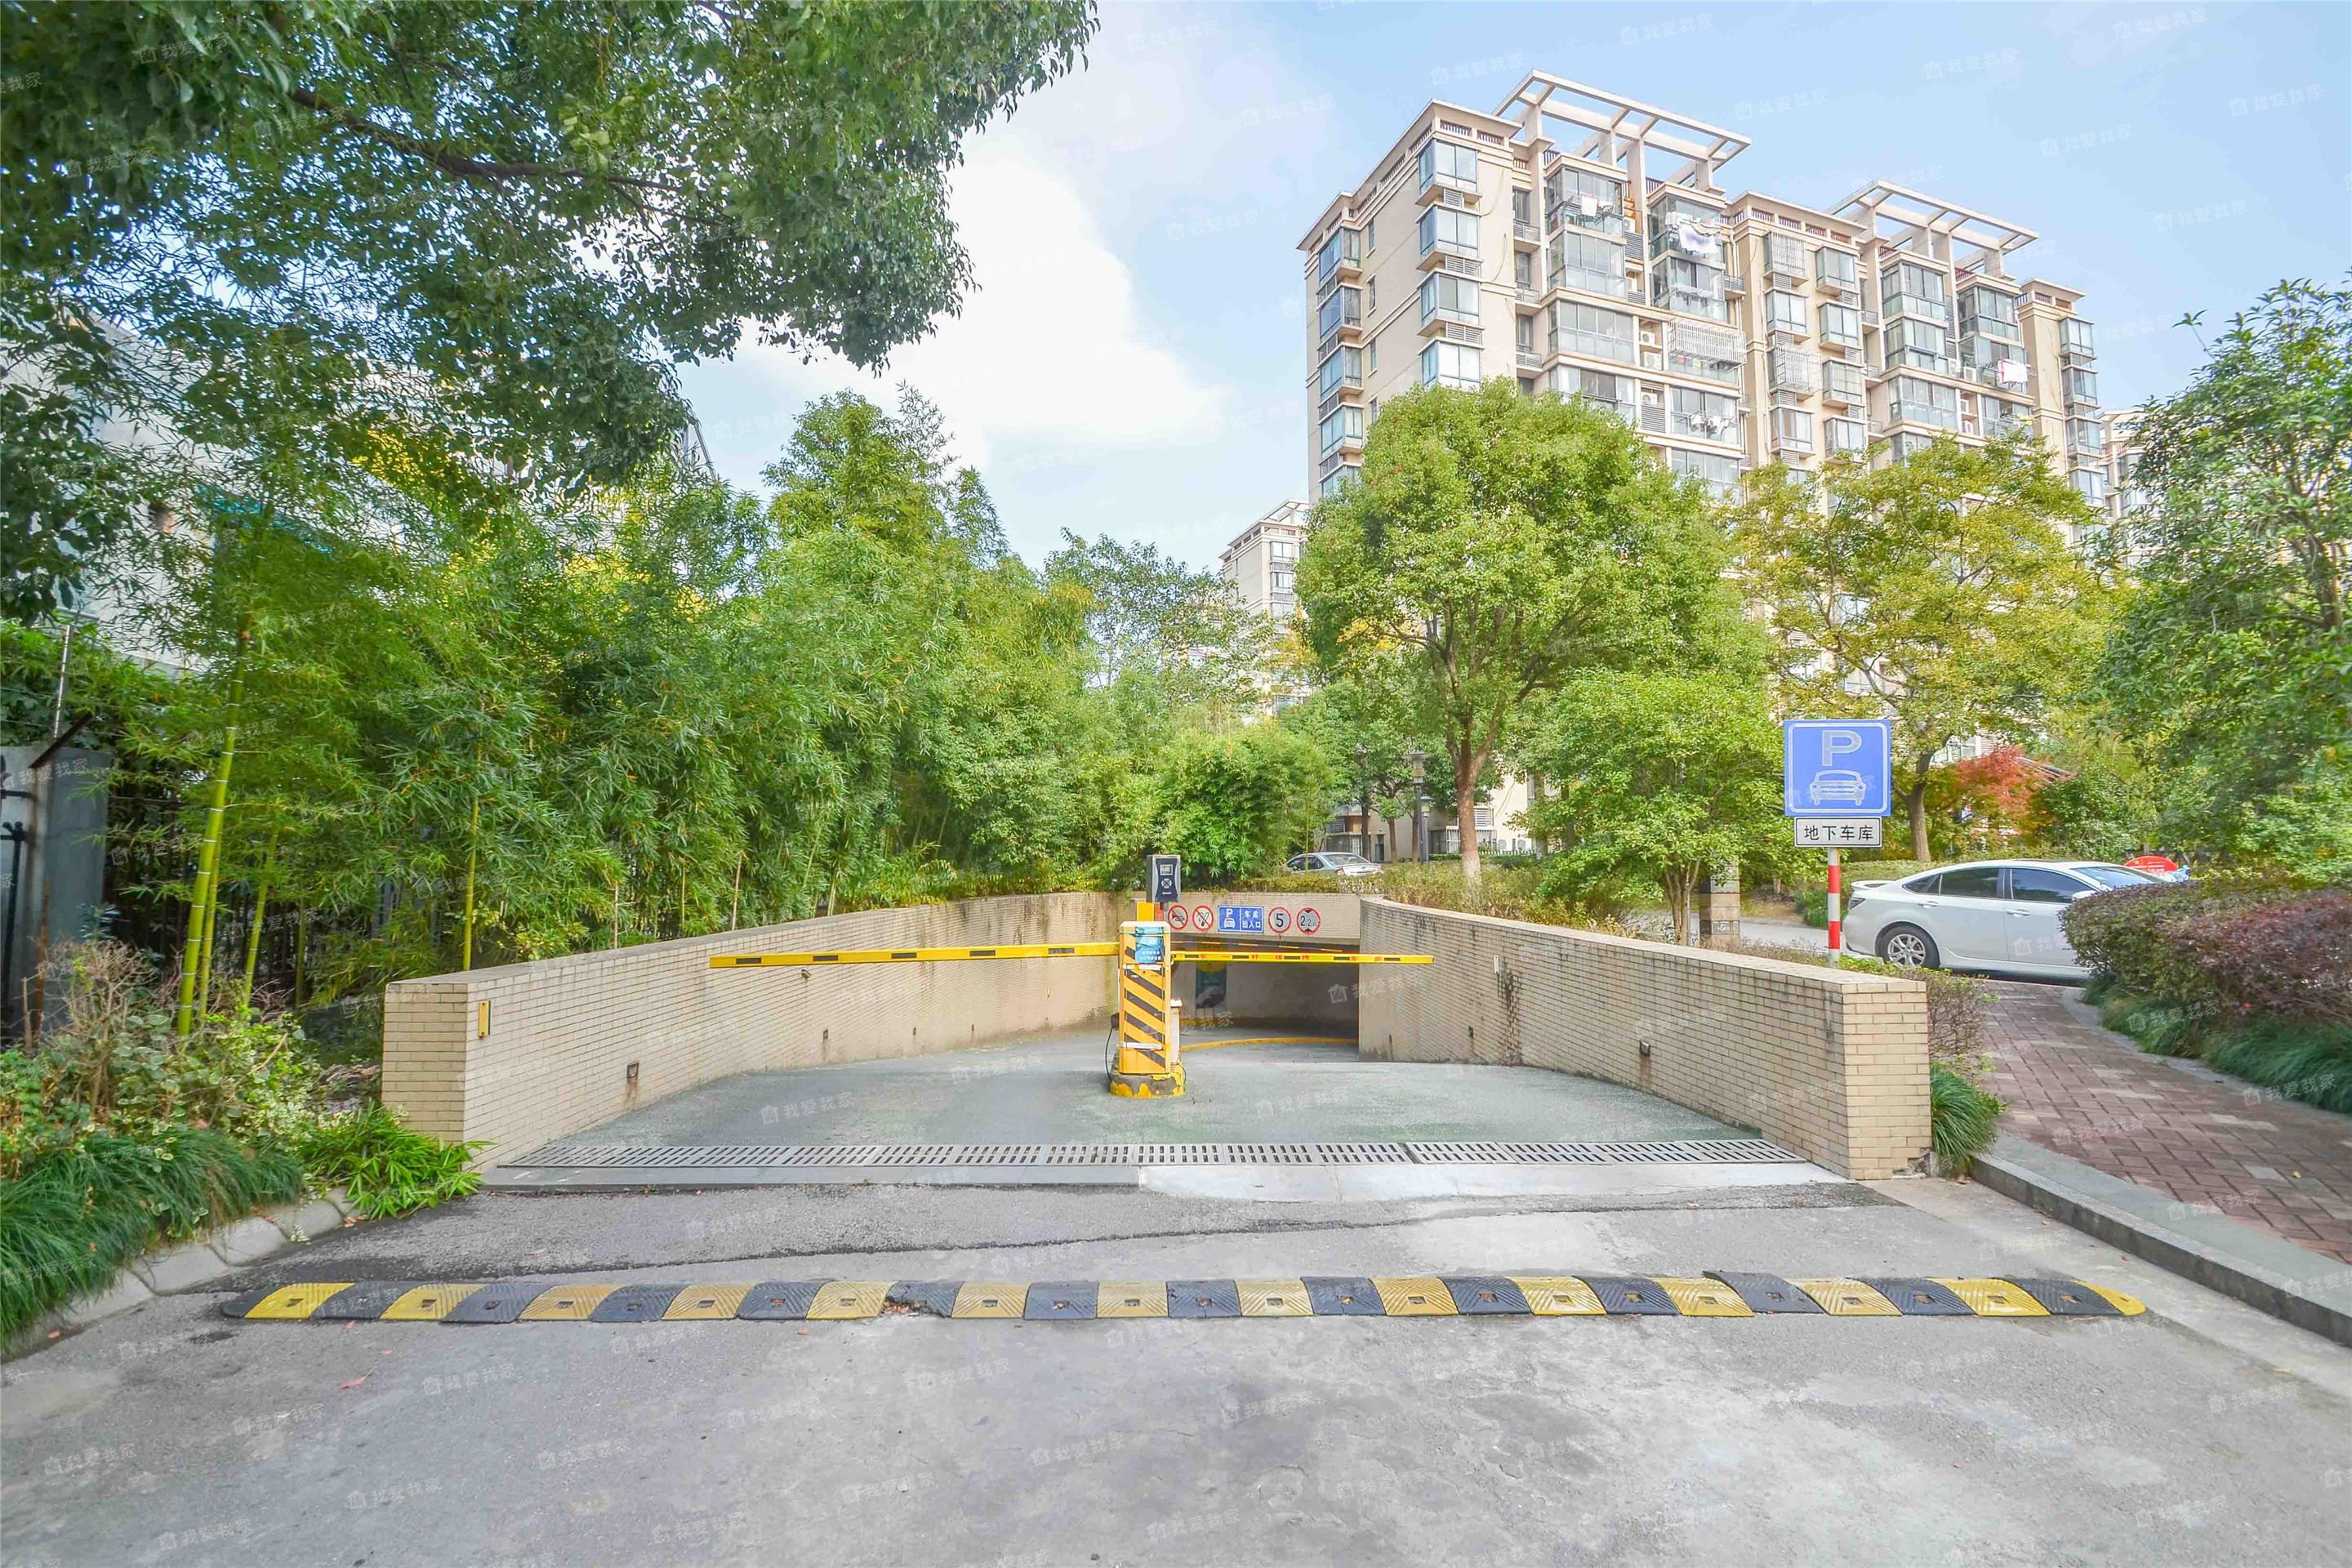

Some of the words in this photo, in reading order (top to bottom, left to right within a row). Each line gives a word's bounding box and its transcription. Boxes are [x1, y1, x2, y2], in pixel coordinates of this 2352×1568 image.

[1822, 729, 1862, 767] P
[1803, 824, 1874, 841] 地下车库
[1226, 908, 1233, 918] P
[1276, 913, 1284, 928] 5
[1242, 920, 1261, 929] 出入口
